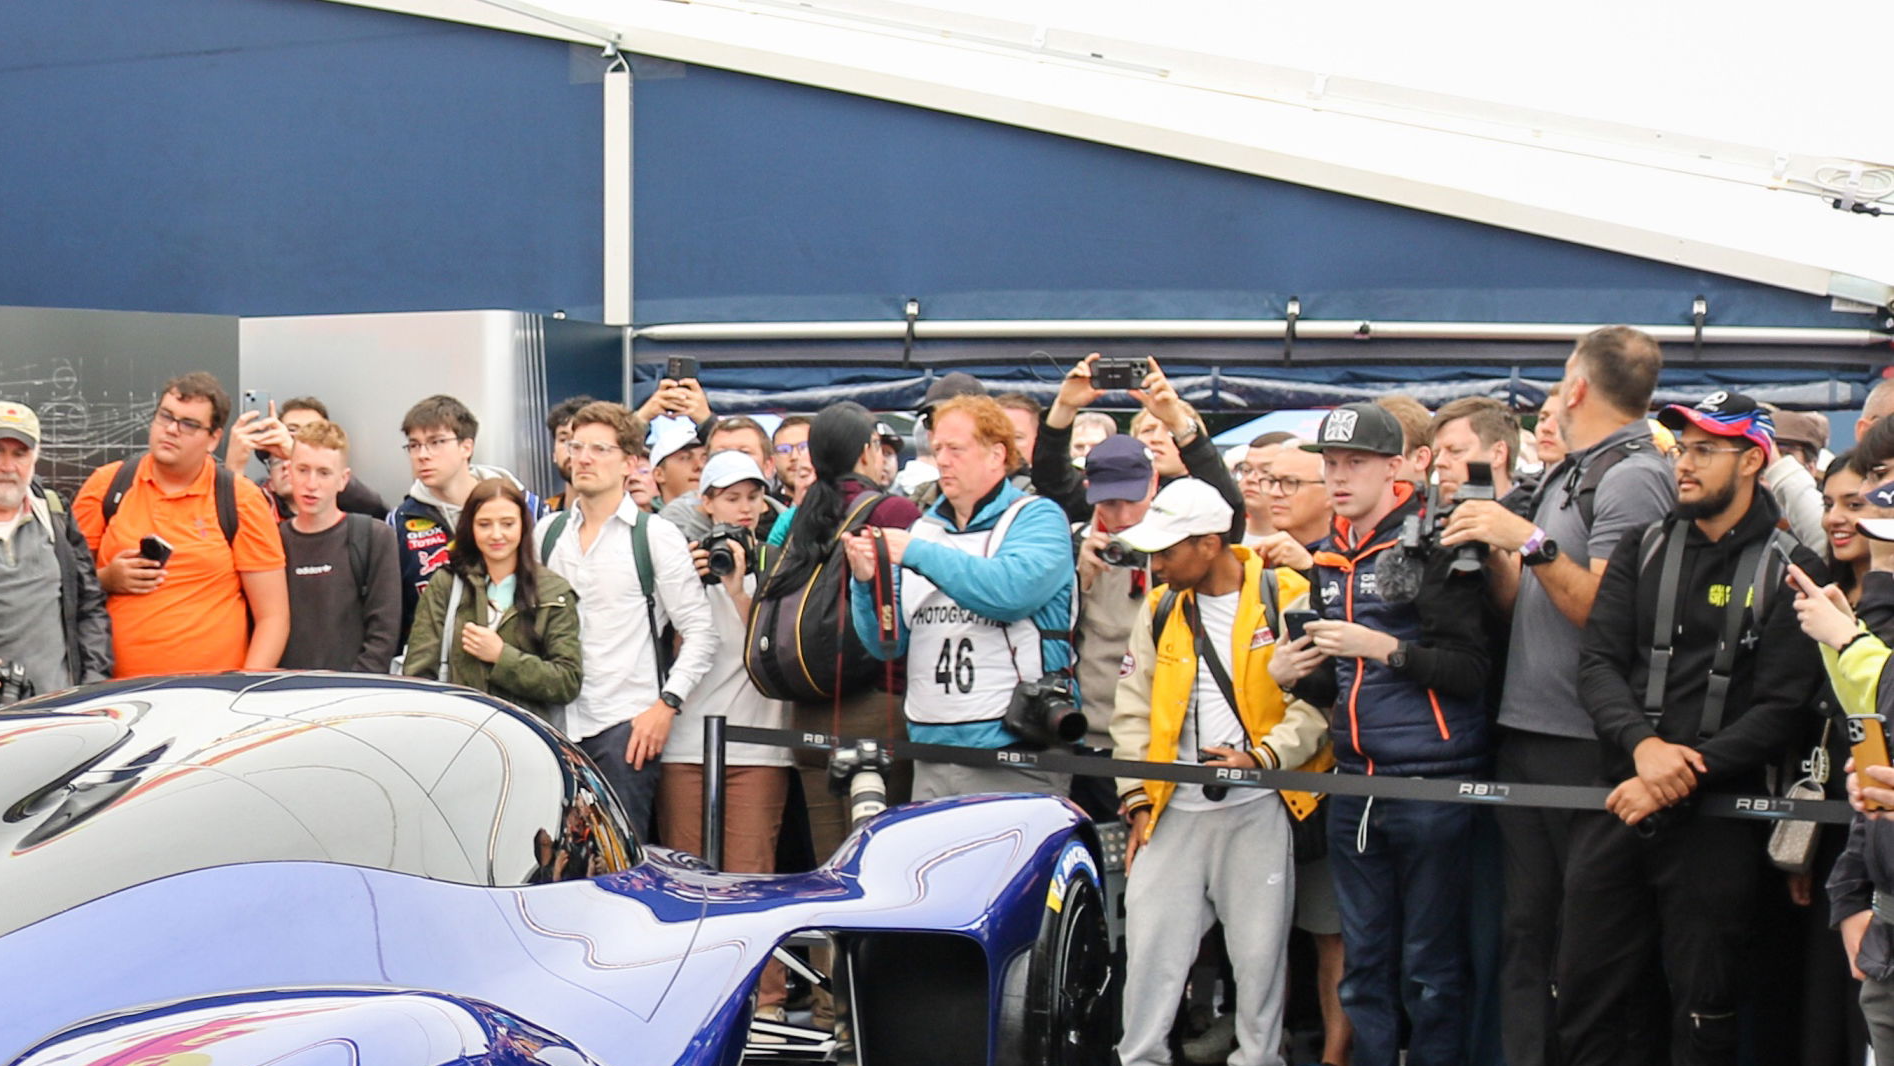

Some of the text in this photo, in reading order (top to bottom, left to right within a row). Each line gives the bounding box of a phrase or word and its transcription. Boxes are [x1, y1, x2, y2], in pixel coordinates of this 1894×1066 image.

[408, 535, 446, 549] TOTAL
[935, 637, 975, 695] 46
[997, 751, 1038, 764] RB17
[1216, 768, 1262, 781] RB17
[1459, 783, 1510, 796] RB17
[1735, 798, 1795, 811] RB17
